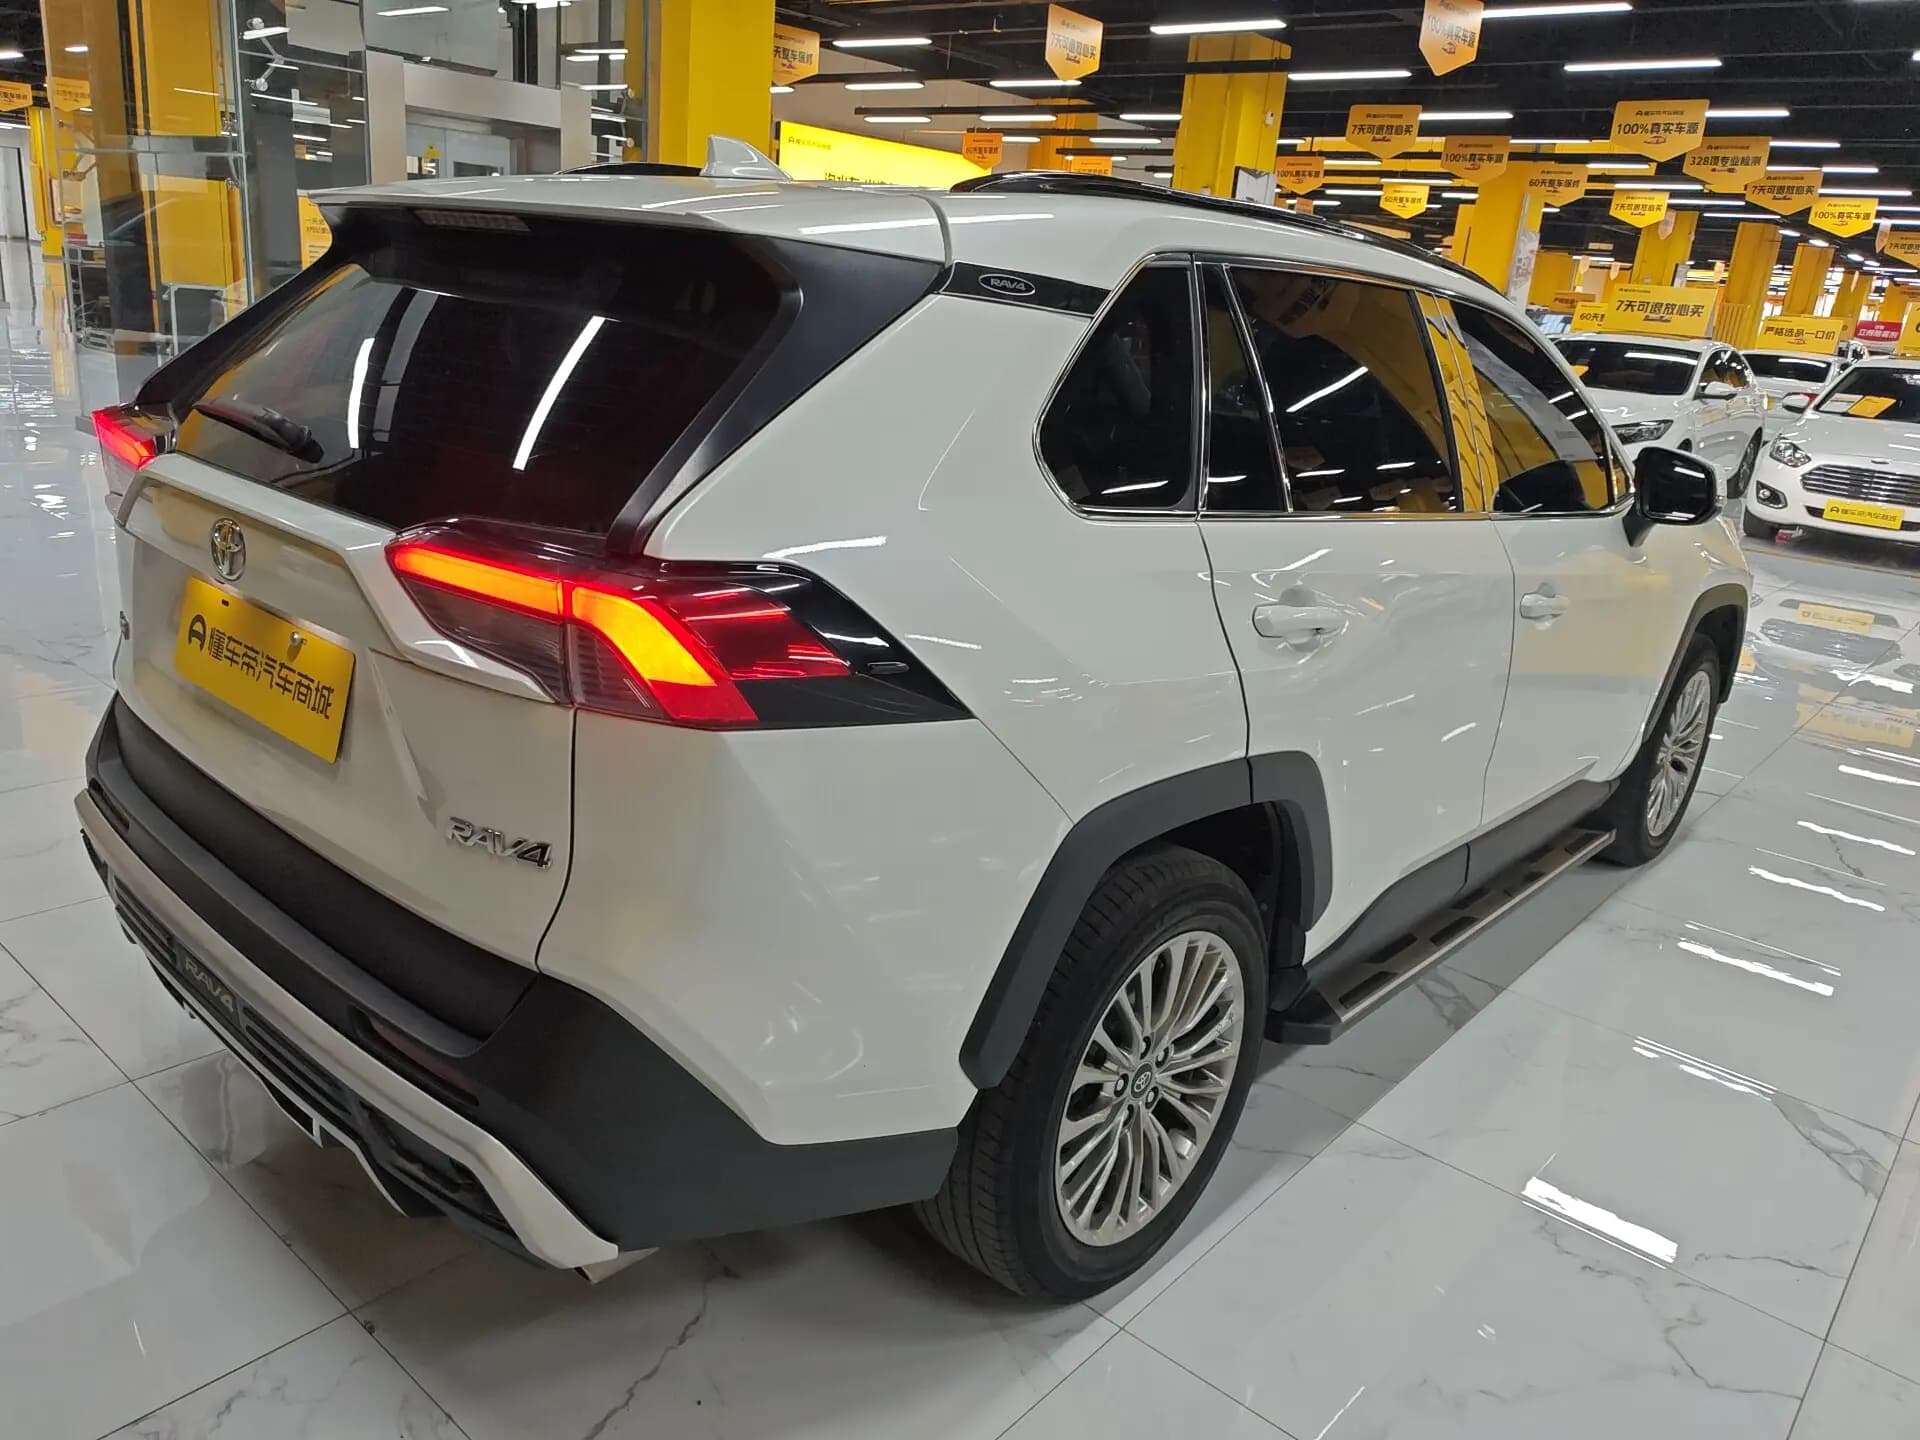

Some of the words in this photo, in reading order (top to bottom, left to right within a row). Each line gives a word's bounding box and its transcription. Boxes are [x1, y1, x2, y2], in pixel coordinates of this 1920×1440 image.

[1352, 124, 1413, 136] 7天可退放心买
[1617, 121, 1700, 135] 100%真实车源
[1445, 153, 1504, 163] 100%真实车源
[1690, 155, 1761, 167] 328项专业检测
[1751, 185, 1815, 195] 7天可退放心买
[1814, 211, 1872, 221] 100%真实车源
[990, 278, 1026, 290] RAV4
[1616, 300, 1705, 318] 7天可退放心买
[1764, 326, 1836, 340] 严格选品一口价
[208, 627, 334, 720] 懂车帝汽车商城
[448, 816, 552, 869] RAV4
[185, 956, 234, 1012] RAV4
